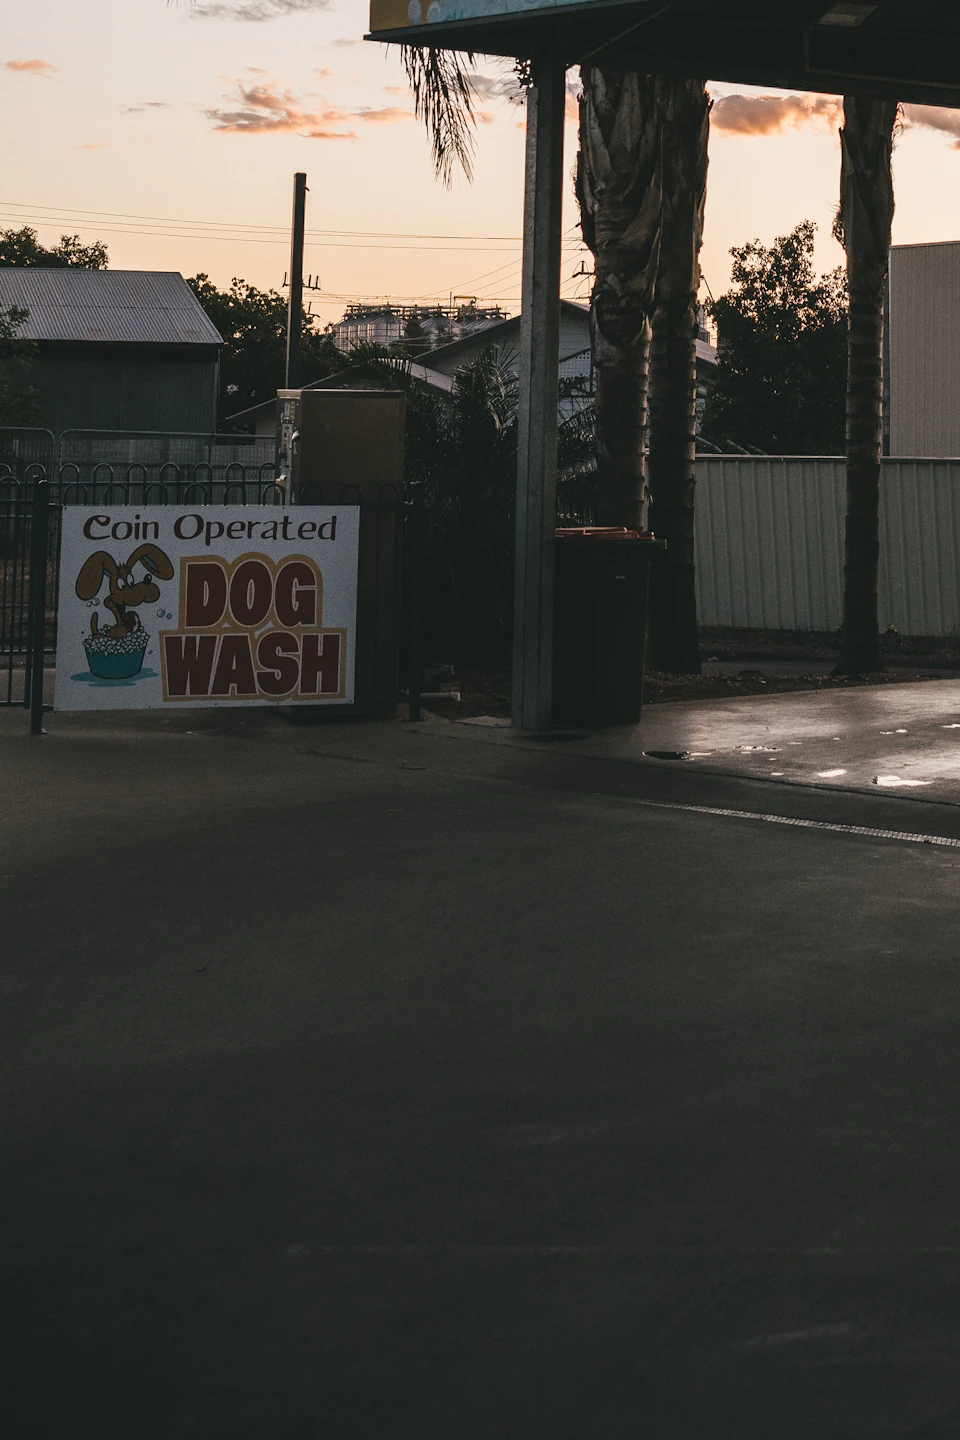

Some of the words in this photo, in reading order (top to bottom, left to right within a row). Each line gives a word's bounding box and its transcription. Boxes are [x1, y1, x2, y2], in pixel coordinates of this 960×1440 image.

[83, 514, 159, 540] Coin
[173, 514, 337, 546] Operated
[185, 559, 318, 629] DOG
[163, 631, 342, 697] WASH
